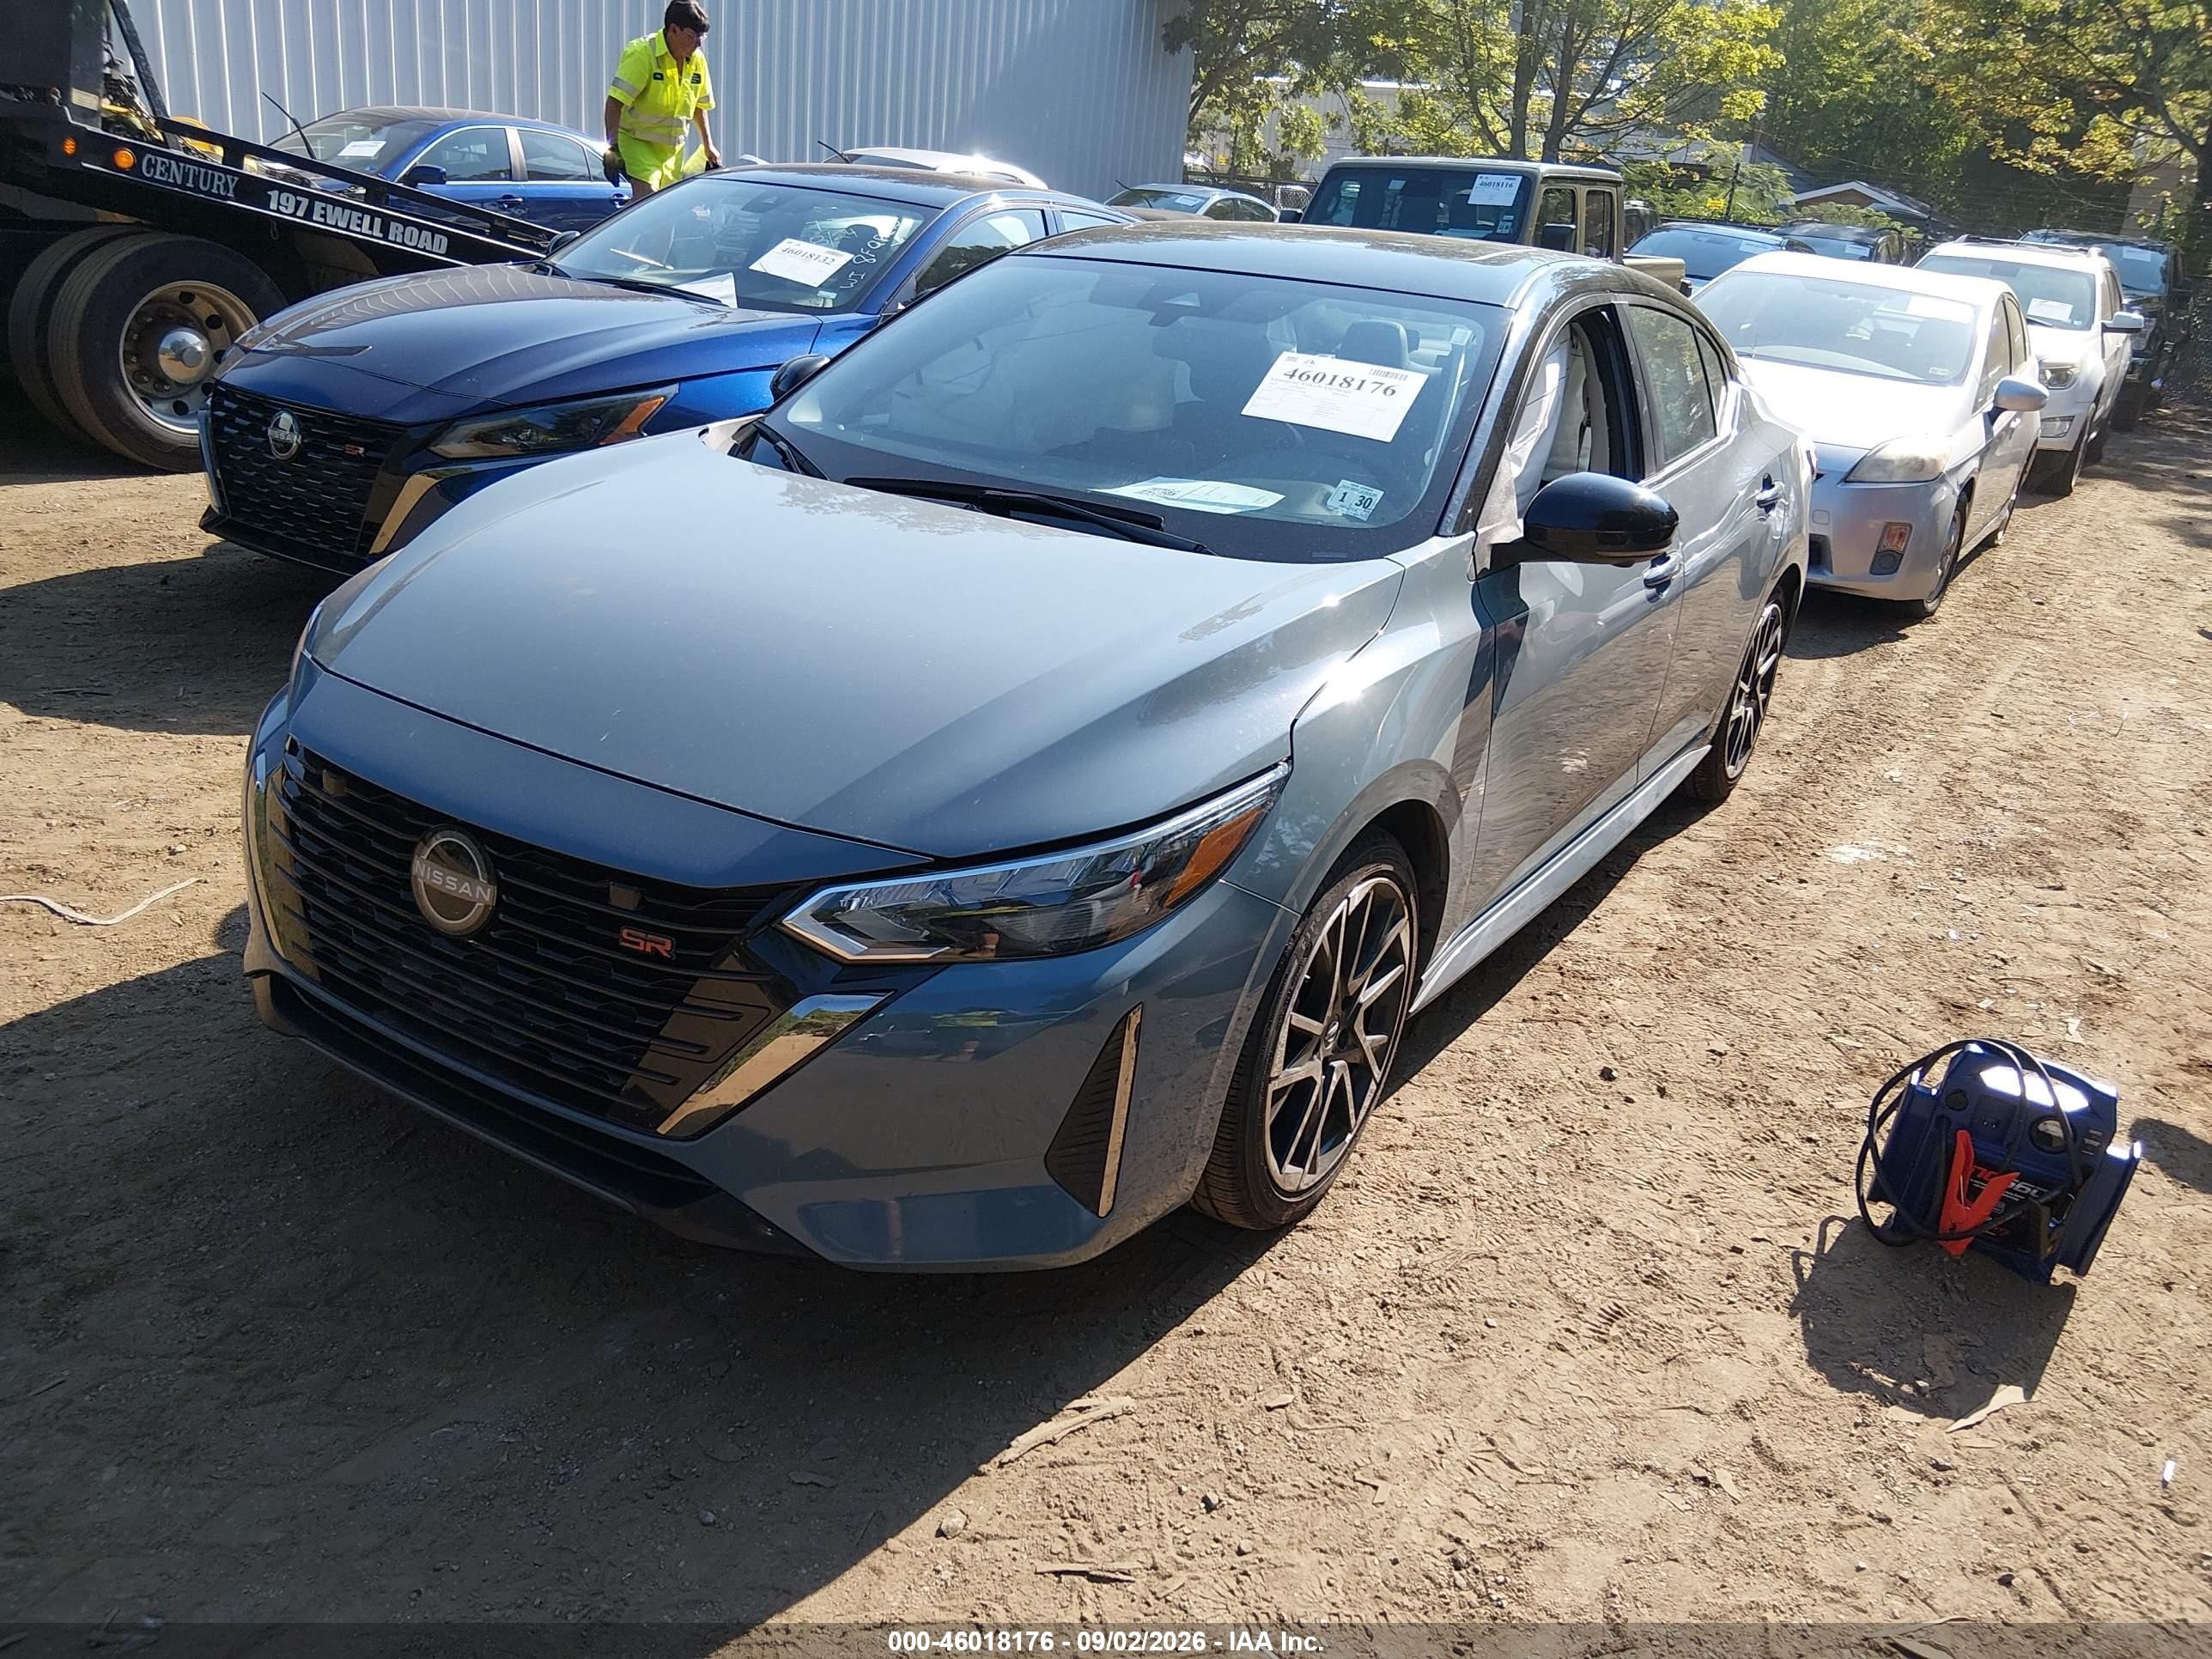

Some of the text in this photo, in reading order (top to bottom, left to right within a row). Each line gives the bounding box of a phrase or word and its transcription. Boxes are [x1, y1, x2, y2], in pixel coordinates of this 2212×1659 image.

[142, 154, 240, 198] CENTURY
[266, 190, 448, 255] 197 EWELL ROAD
[1284, 368, 1397, 398] 46018176
[1338, 491, 1373, 509] 1 30
[415, 859, 491, 902] NISSAN
[621, 927, 675, 958] SR
